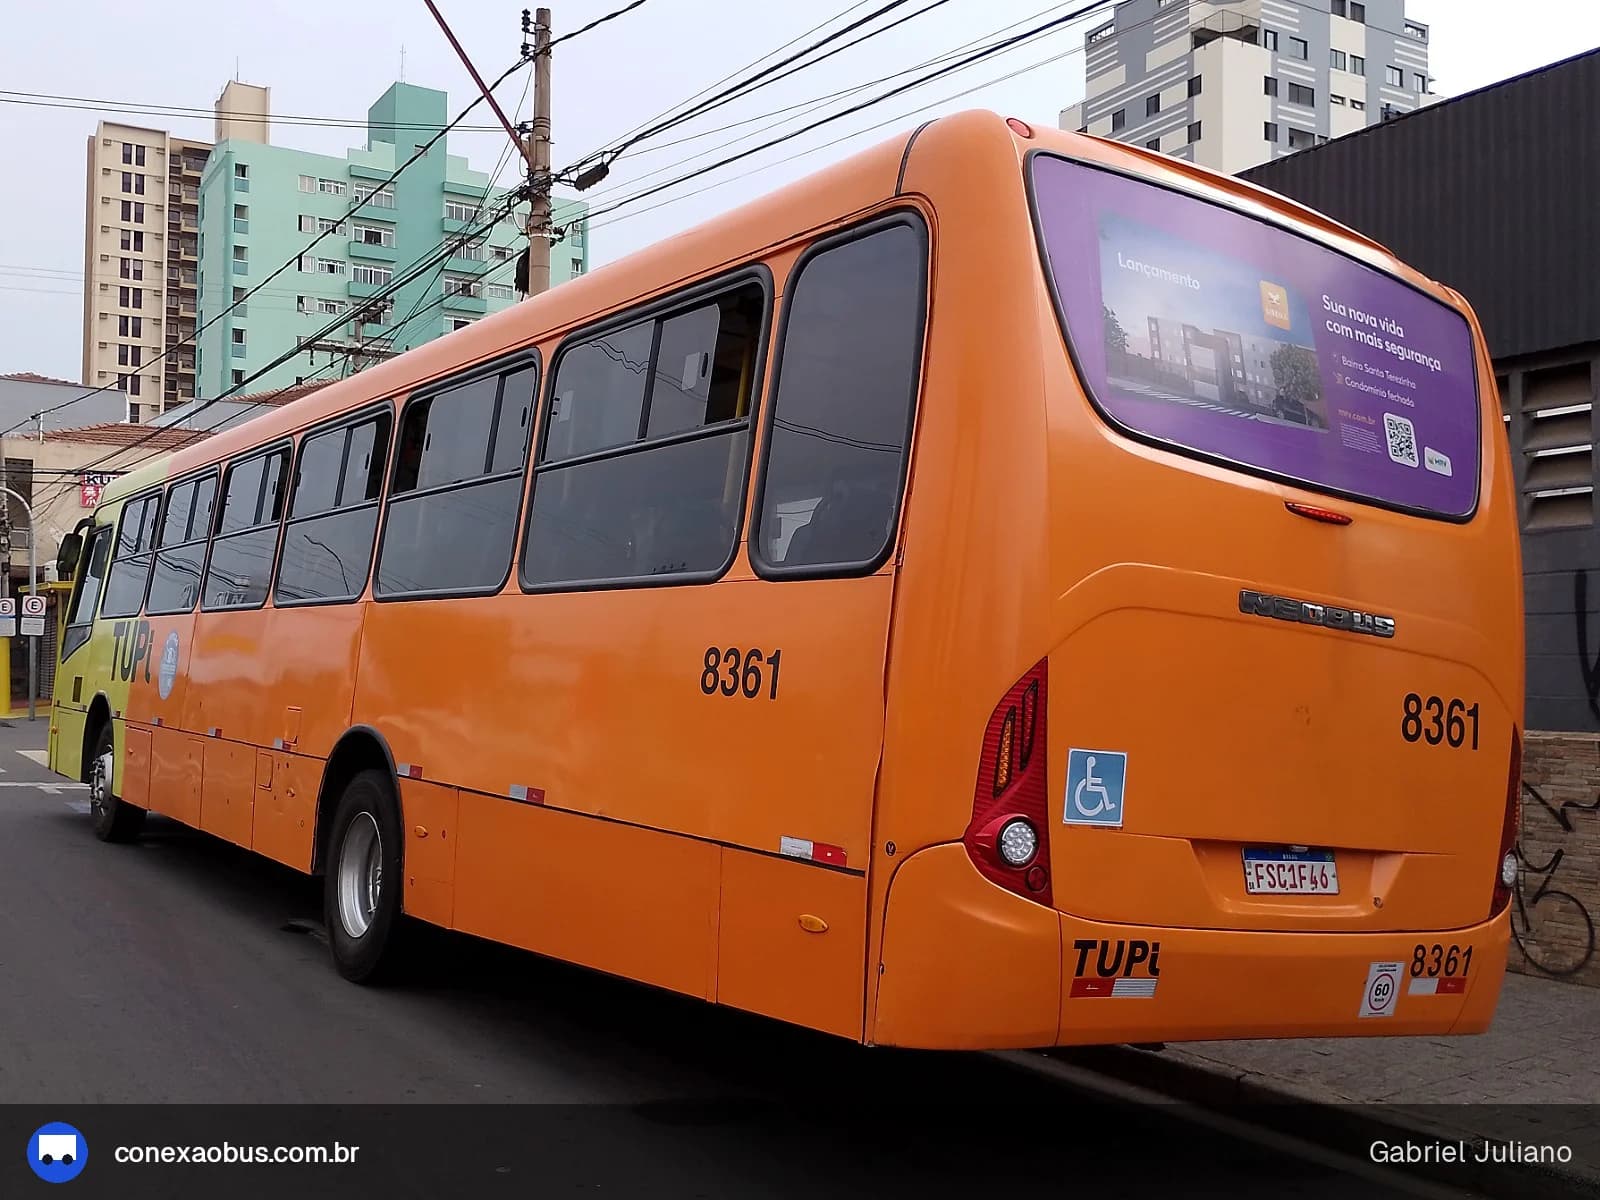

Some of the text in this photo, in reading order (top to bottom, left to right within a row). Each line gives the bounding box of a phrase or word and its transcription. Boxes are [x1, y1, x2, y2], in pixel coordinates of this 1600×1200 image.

[1117, 252, 1201, 290] Lançamento
[1322, 294, 1405, 338] Sua nova vida
[1326, 320, 1442, 371] com mais segurança
[1341, 355, 1417, 389] Bairro Santa Terezinha
[1387, 389, 1416, 408] fechado
[1, 602, 9, 611] E
[31, 601, 39, 610] E
[1239, 589, 1395, 638] NEOBUS
[700, 646, 781, 700] 8361
[1401, 692, 1479, 751] 8361
[1254, 863, 1328, 890] FSC1F46
[1410, 943, 1473, 977] 8361
[1374, 983, 1390, 997] 60
